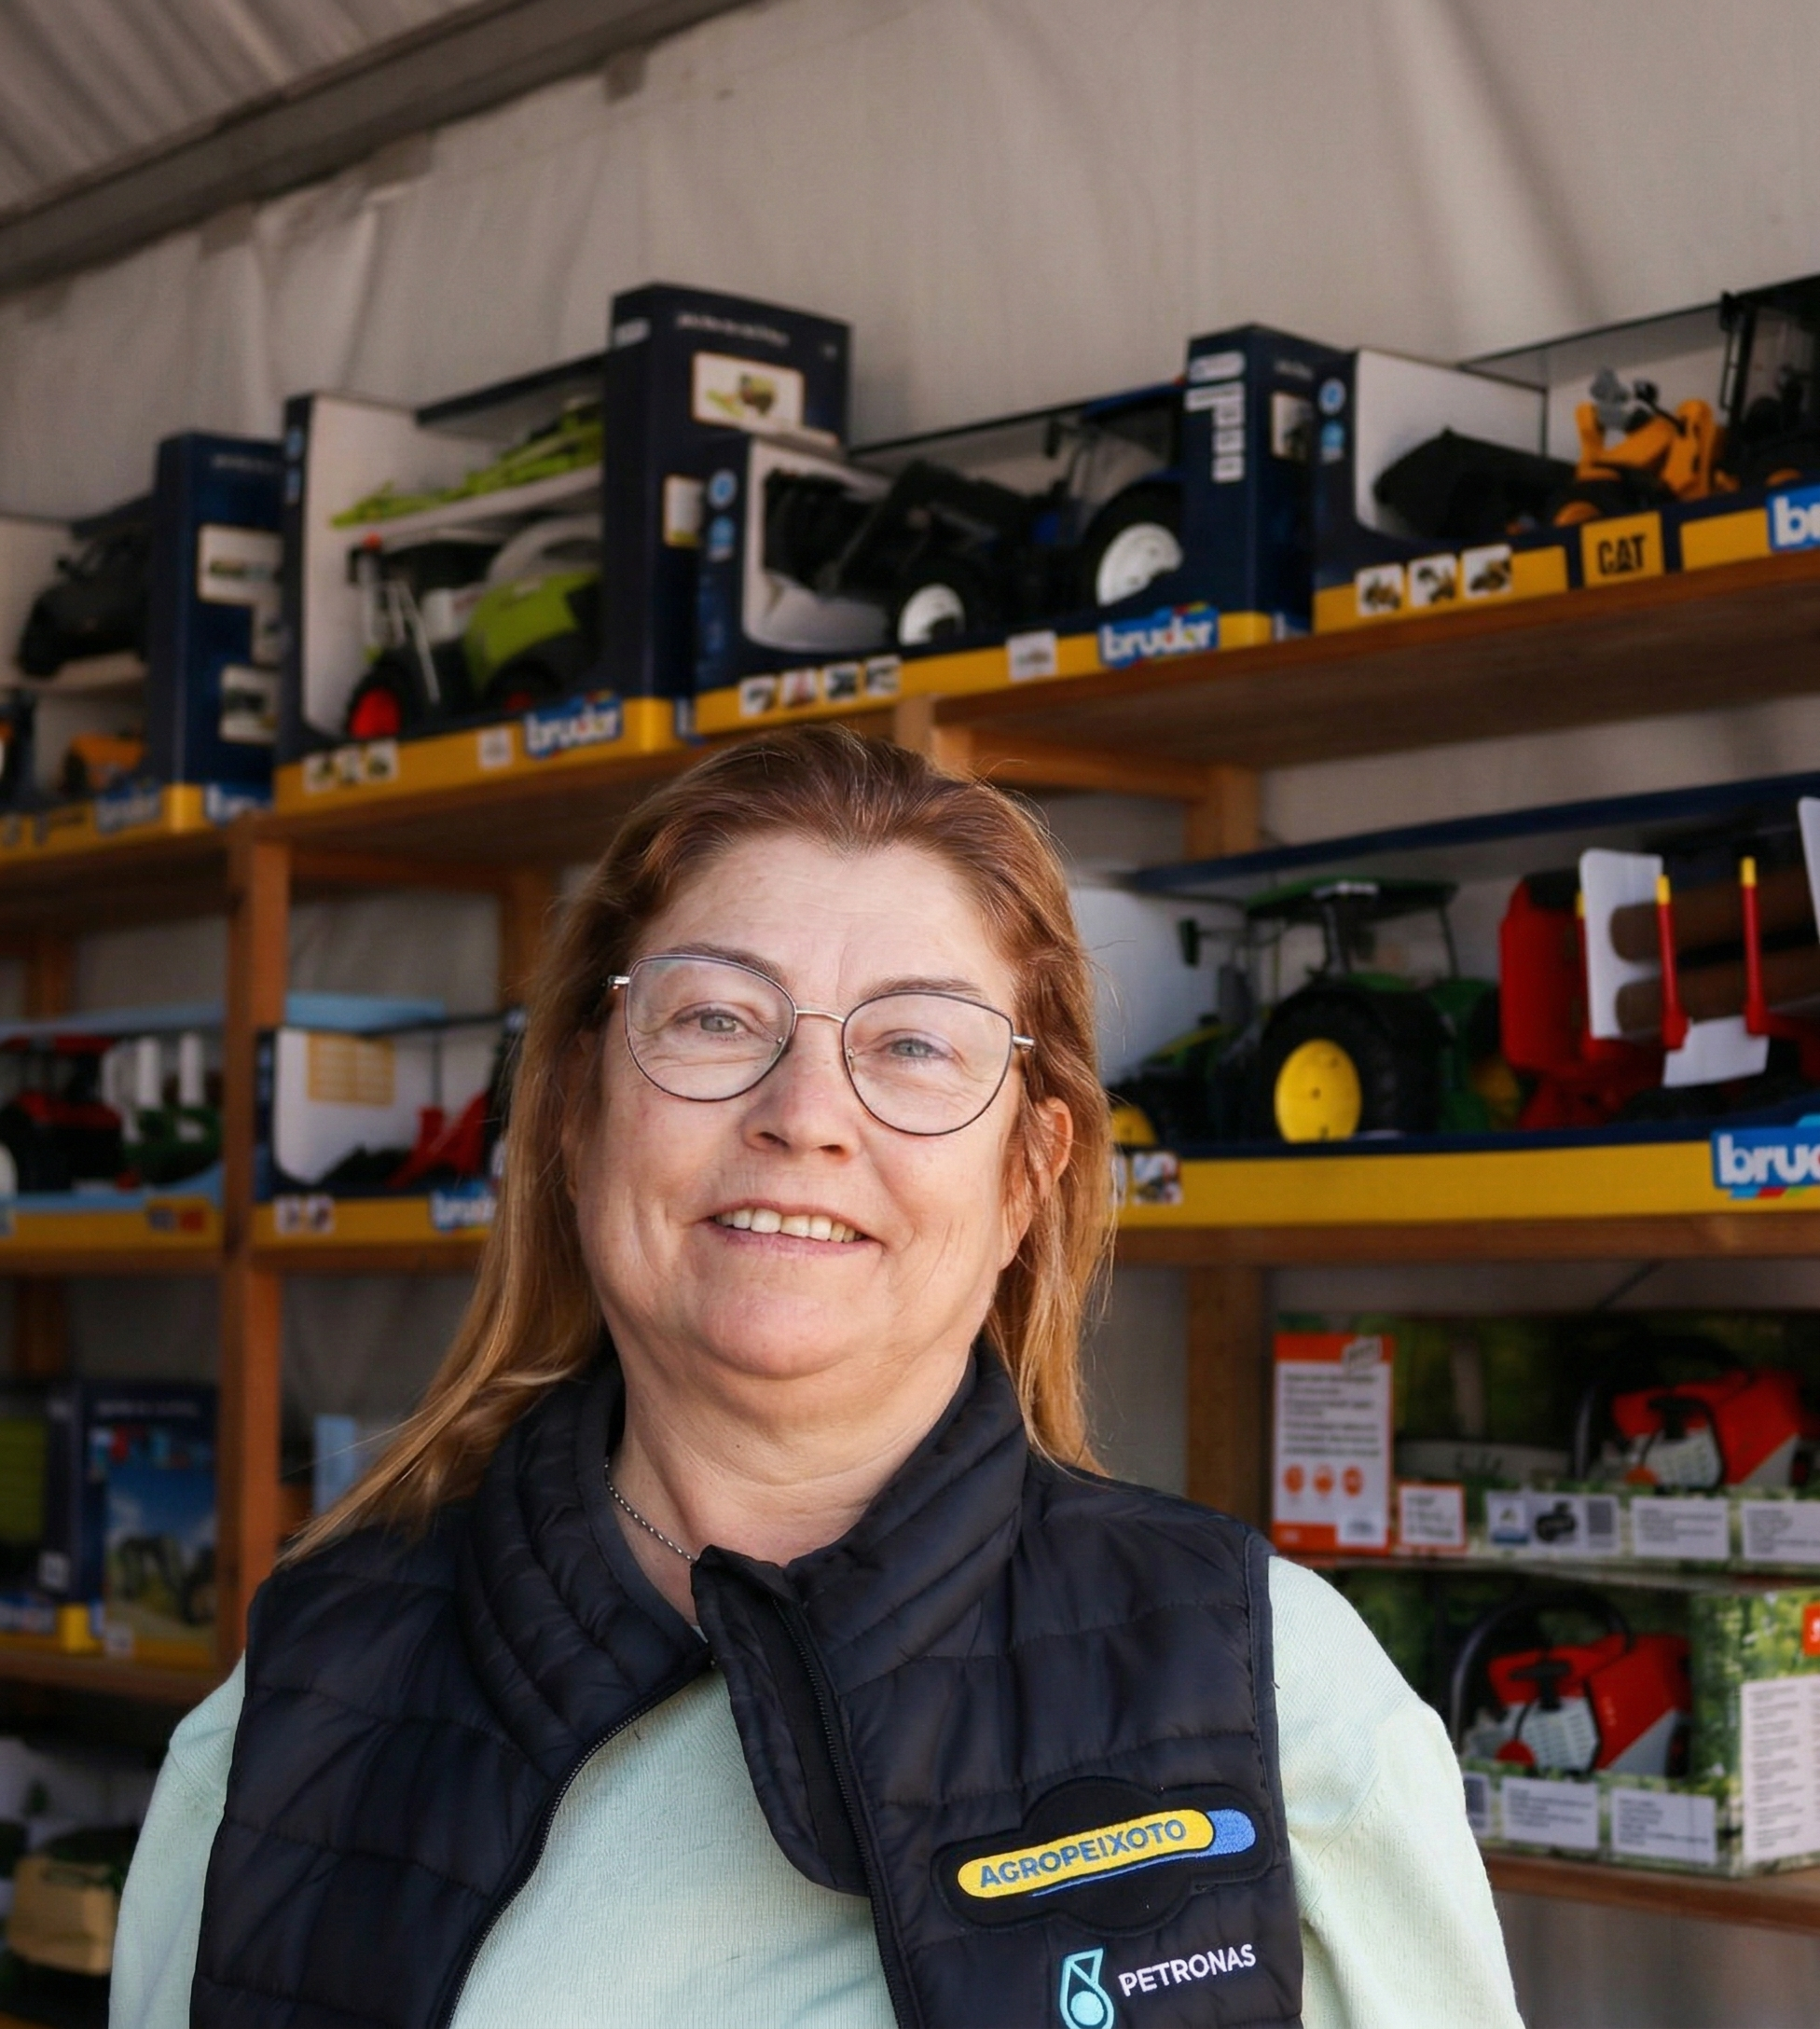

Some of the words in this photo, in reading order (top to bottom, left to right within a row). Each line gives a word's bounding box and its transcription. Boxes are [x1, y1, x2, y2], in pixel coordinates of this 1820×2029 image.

[1597, 532, 1647, 576] CAT
[979, 1818, 1187, 1888] AGROPEIXOTO
[1118, 1942, 1257, 1997] PETRONAS
